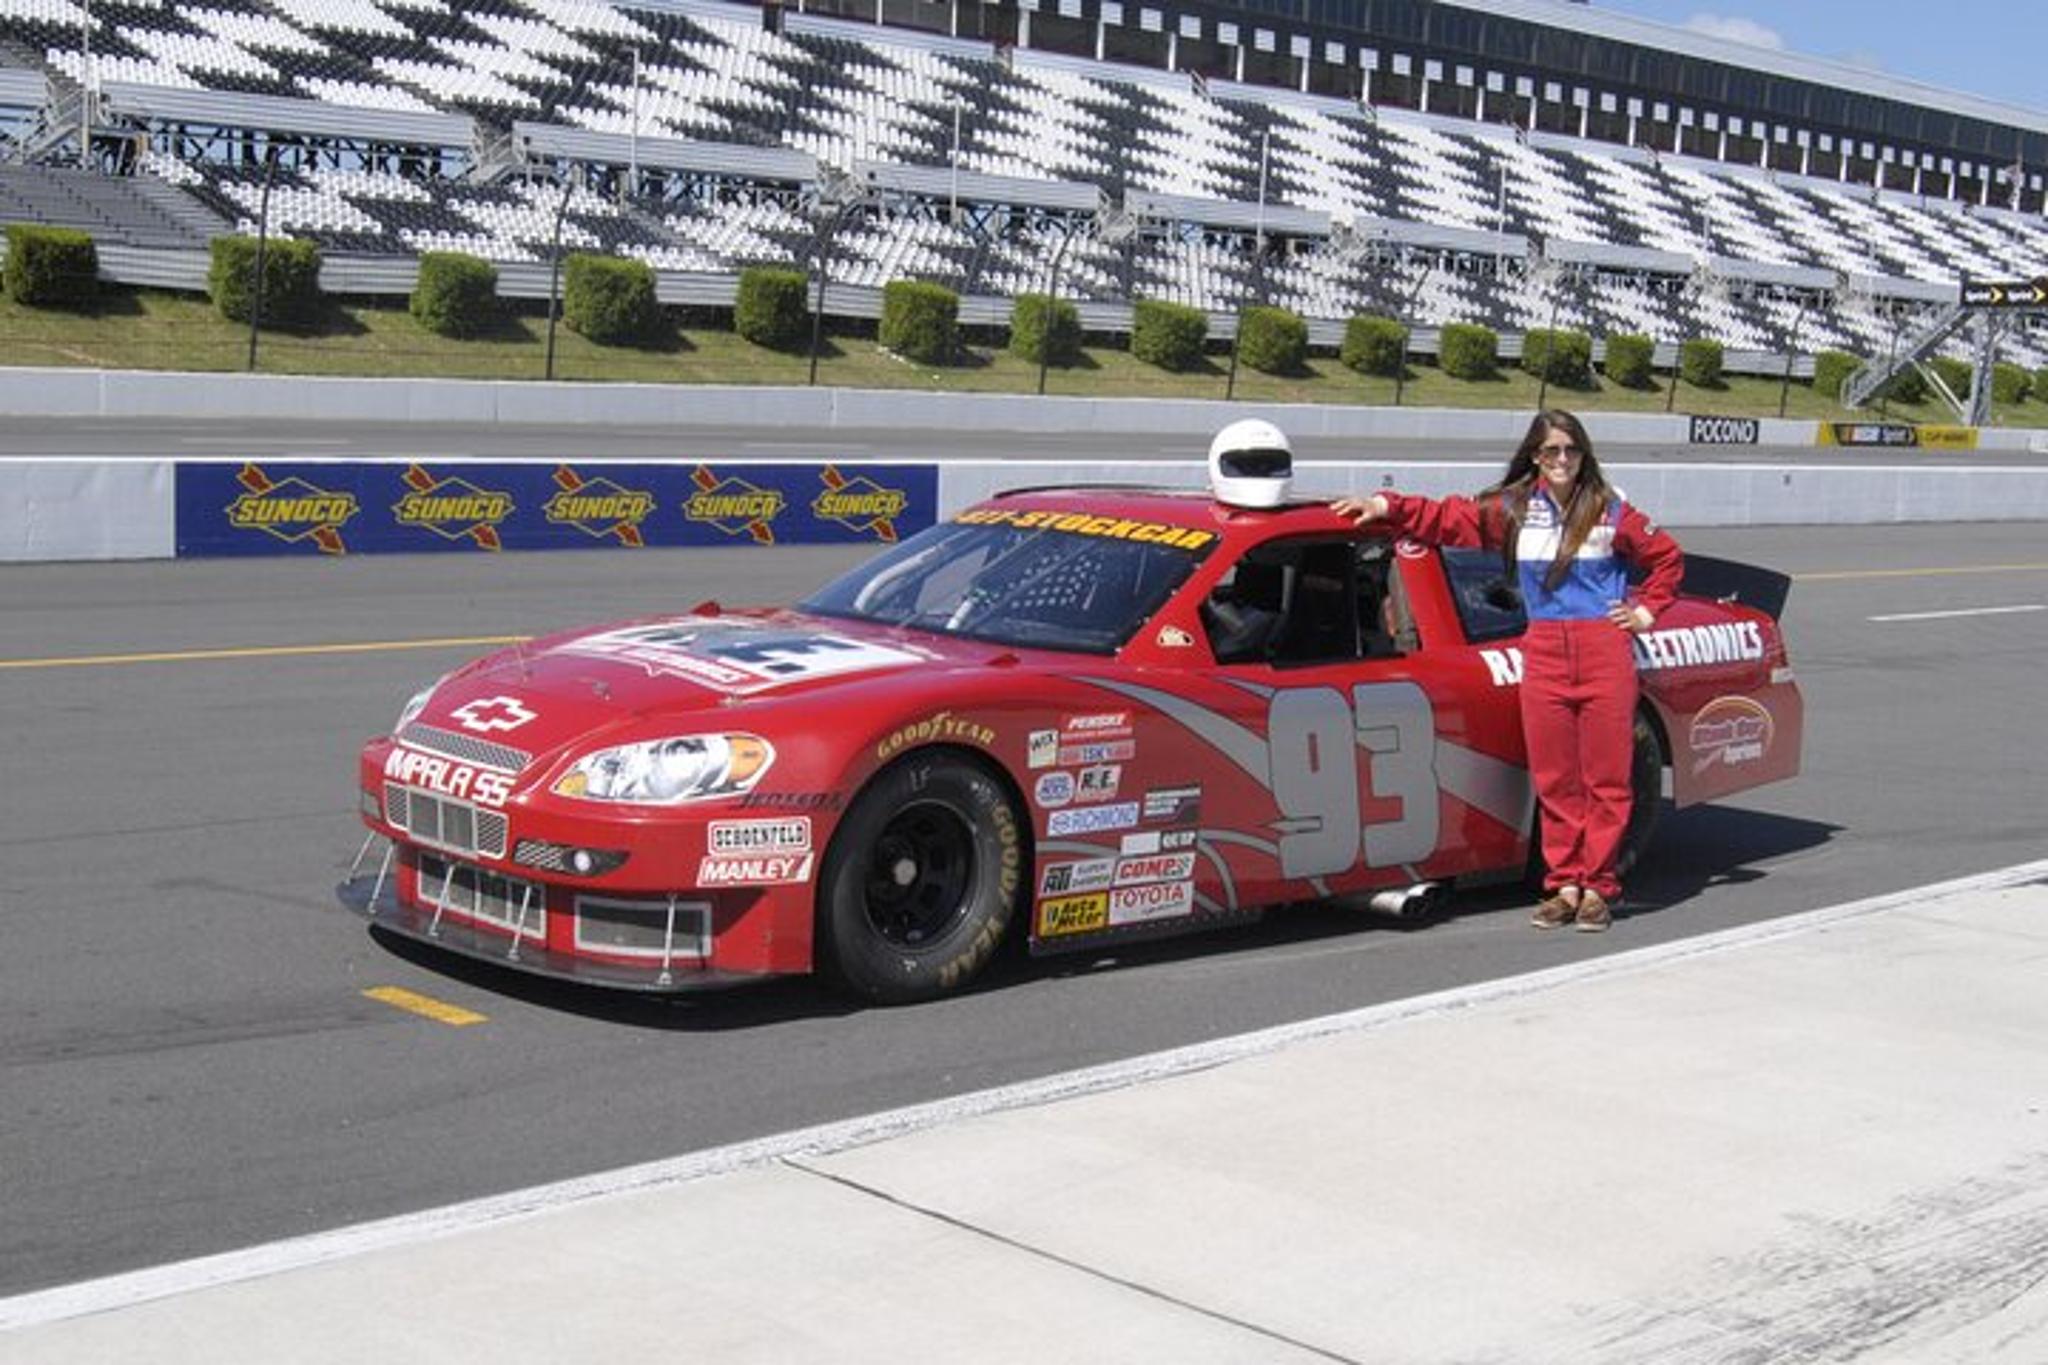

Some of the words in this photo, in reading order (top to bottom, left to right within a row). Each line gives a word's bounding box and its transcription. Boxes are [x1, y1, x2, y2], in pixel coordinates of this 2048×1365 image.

[1695, 419, 1755, 441] POCONO
[237, 498, 351, 522] SUNOCO
[403, 498, 504, 520] SUNOCO
[552, 496, 646, 519] SUNOCO
[690, 495, 778, 517] SUNOCO
[818, 494, 901, 516] SUNOCO
[1633, 620, 1763, 669] LECTRONICS
[877, 711, 995, 759] GOODYEAR
[384, 747, 475, 797] IMPALA
[471, 772, 516, 806] SS
[1269, 680, 1440, 879] 93
[704, 858, 794, 881] MANLEY
[1114, 884, 1184, 908] TOYOTA
